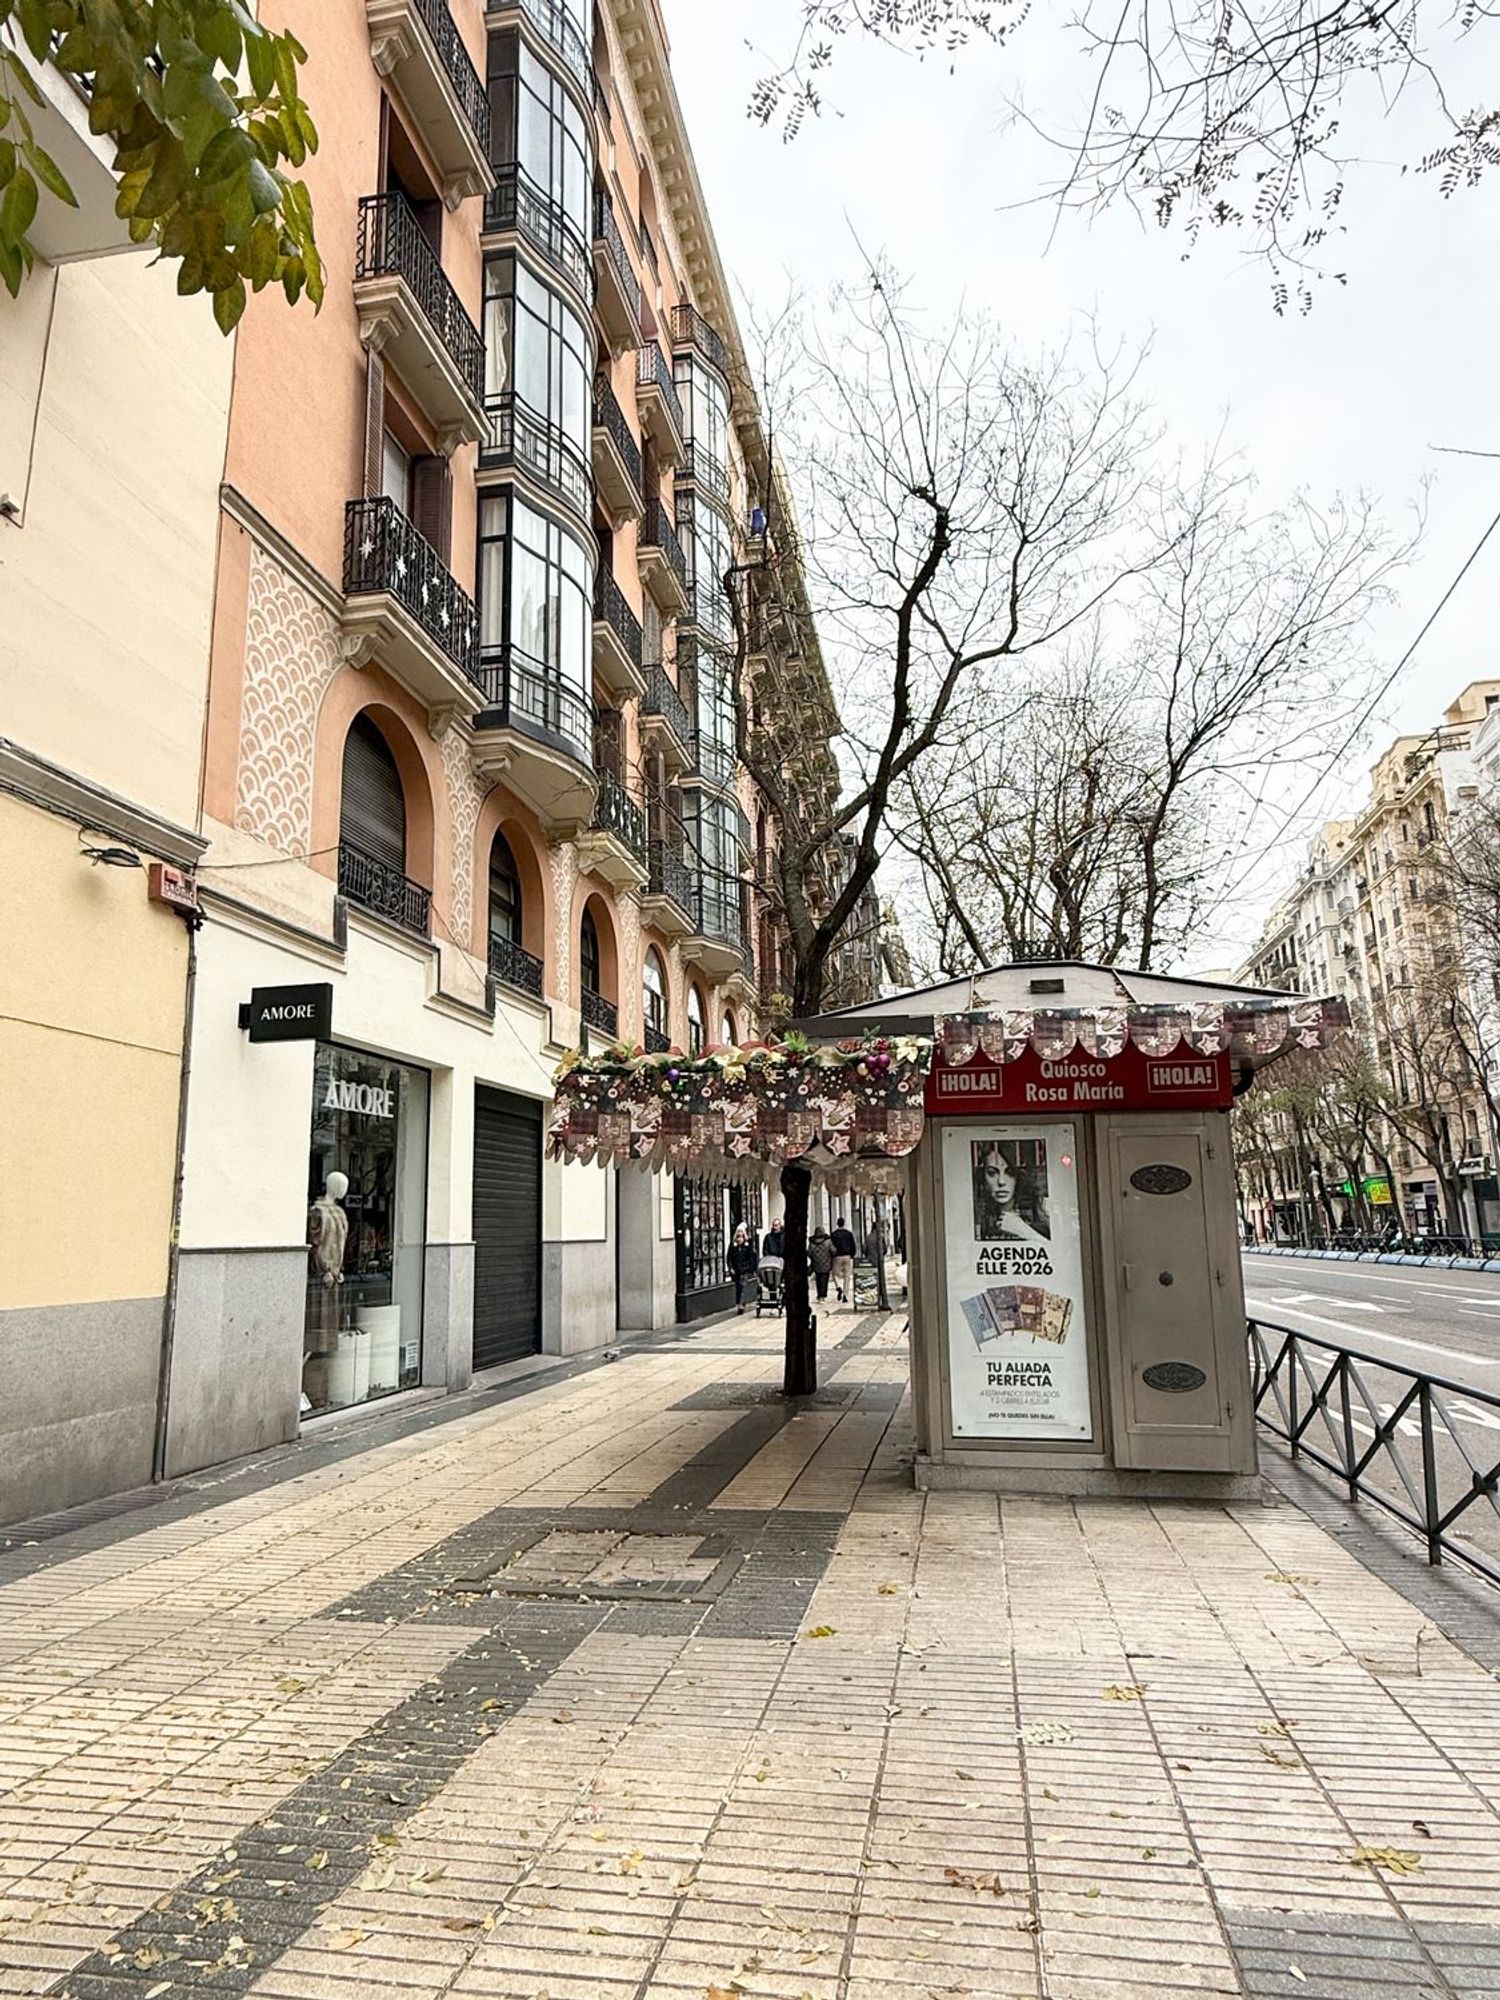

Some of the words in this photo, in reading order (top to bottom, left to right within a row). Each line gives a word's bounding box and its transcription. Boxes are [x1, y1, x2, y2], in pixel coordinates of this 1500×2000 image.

[260, 1004, 316, 1021] AMORE
[1040, 1060, 1106, 1079] Quiosco
[1152, 1066, 1212, 1086] ¡HOLA!
[942, 1073, 997, 1092] ¡HOLA!
[1025, 1083, 1067, 1101] Rosa
[1073, 1081, 1124, 1101] María
[322, 1076, 394, 1118] AMORE
[979, 1247, 1049, 1260] AGENDA
[976, 1262, 1007, 1275] ELLE
[1012, 1261, 1053, 1275] 2026
[986, 1362, 1002, 1372] TU
[1005, 1362, 1051, 1374] ALIADA
[987, 1374, 1053, 1387] PERFECTA
